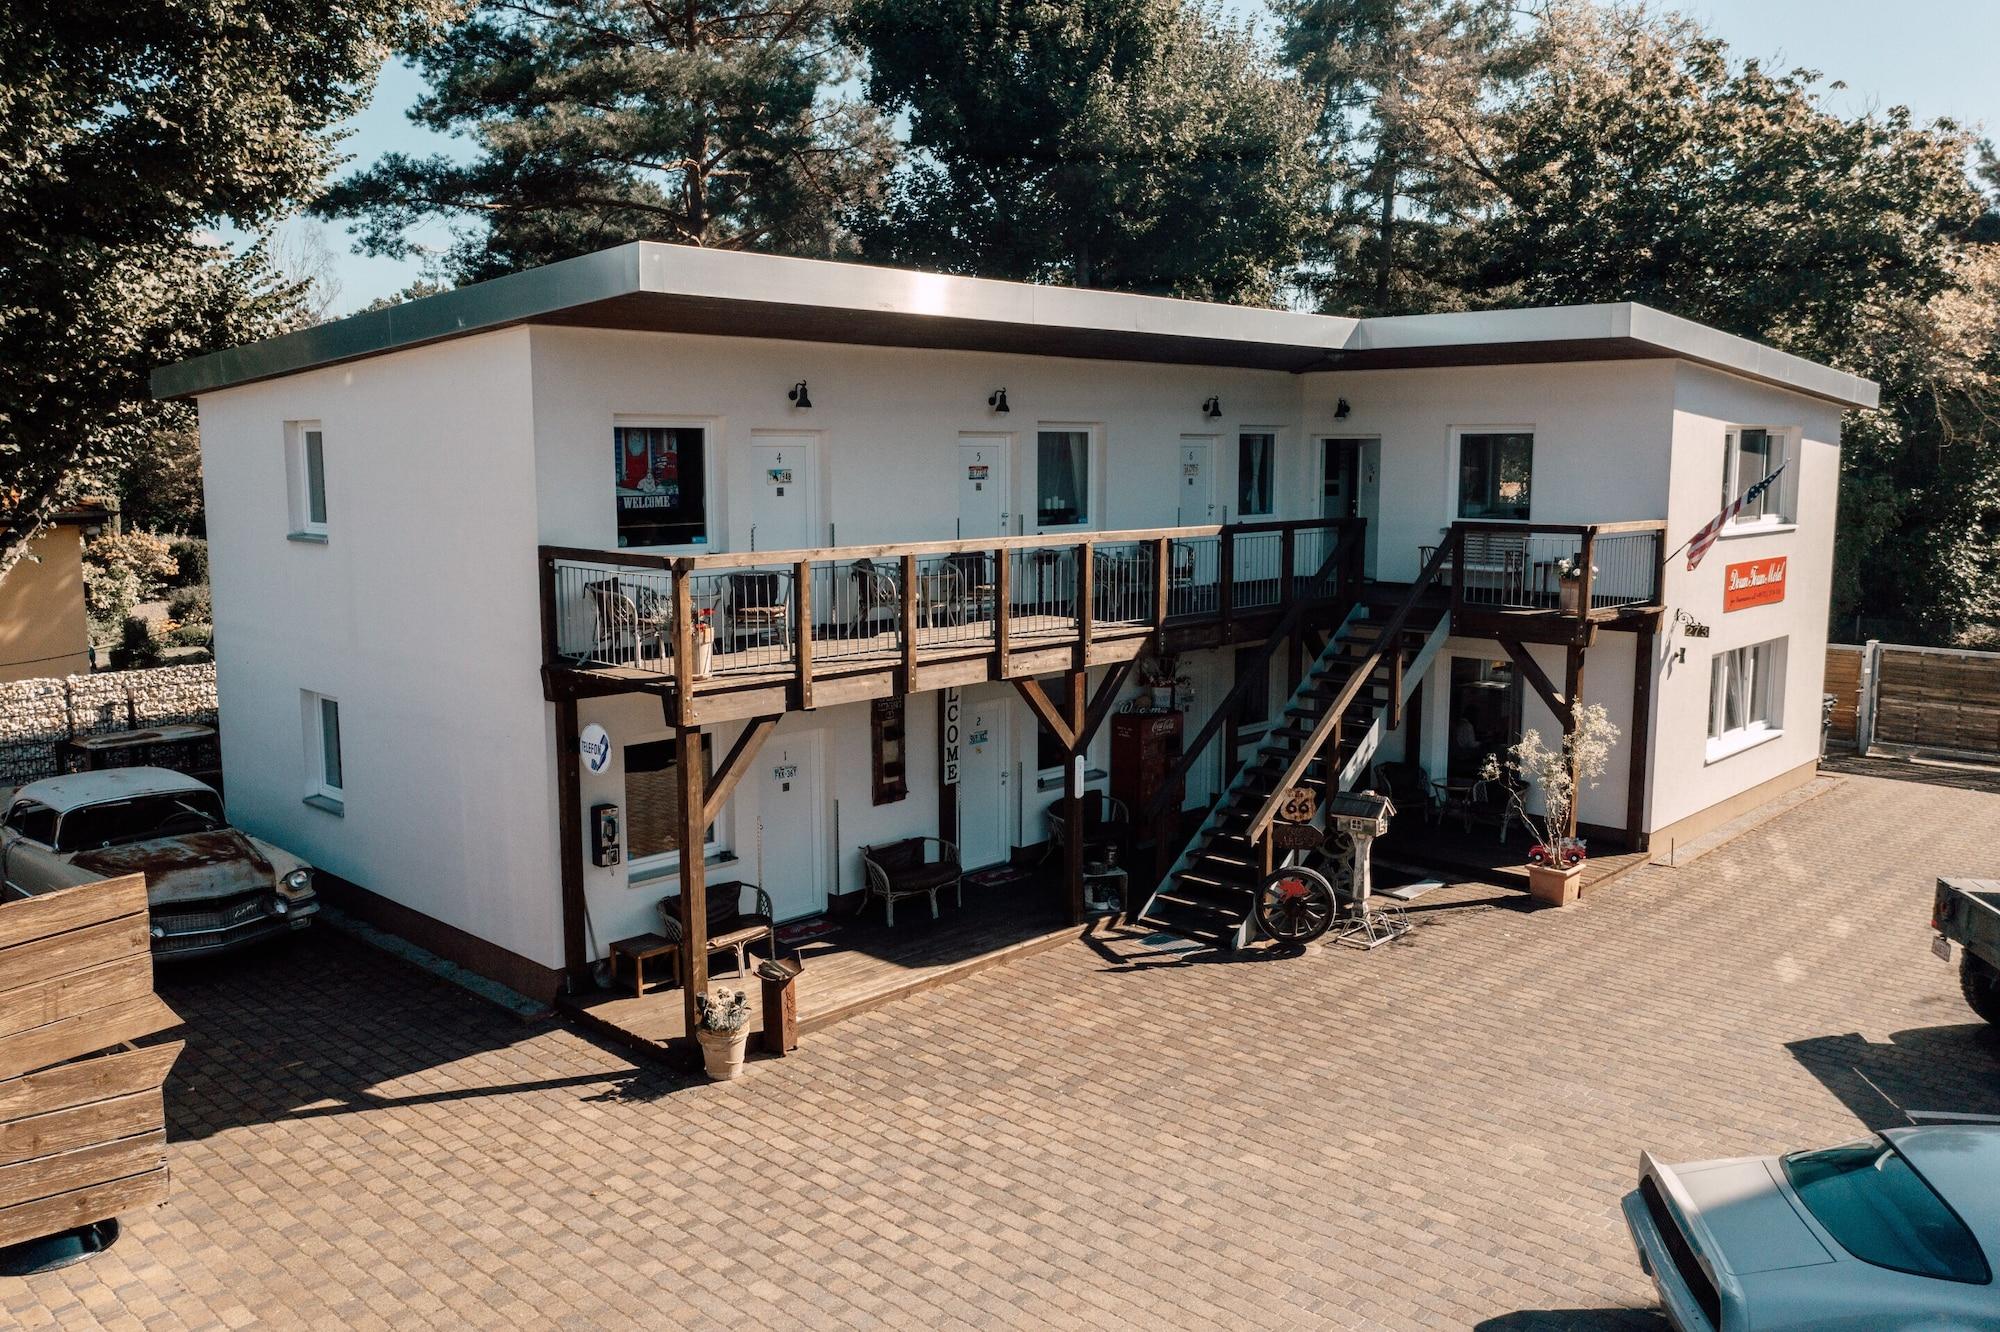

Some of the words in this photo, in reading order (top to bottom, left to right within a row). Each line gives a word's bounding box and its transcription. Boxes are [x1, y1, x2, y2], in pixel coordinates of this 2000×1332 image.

[623, 496, 671, 509] WELCOME
[1686, 625, 1709, 637] 273
[581, 740, 601, 755] TELEFON
[1286, 798, 1310, 815] 66
